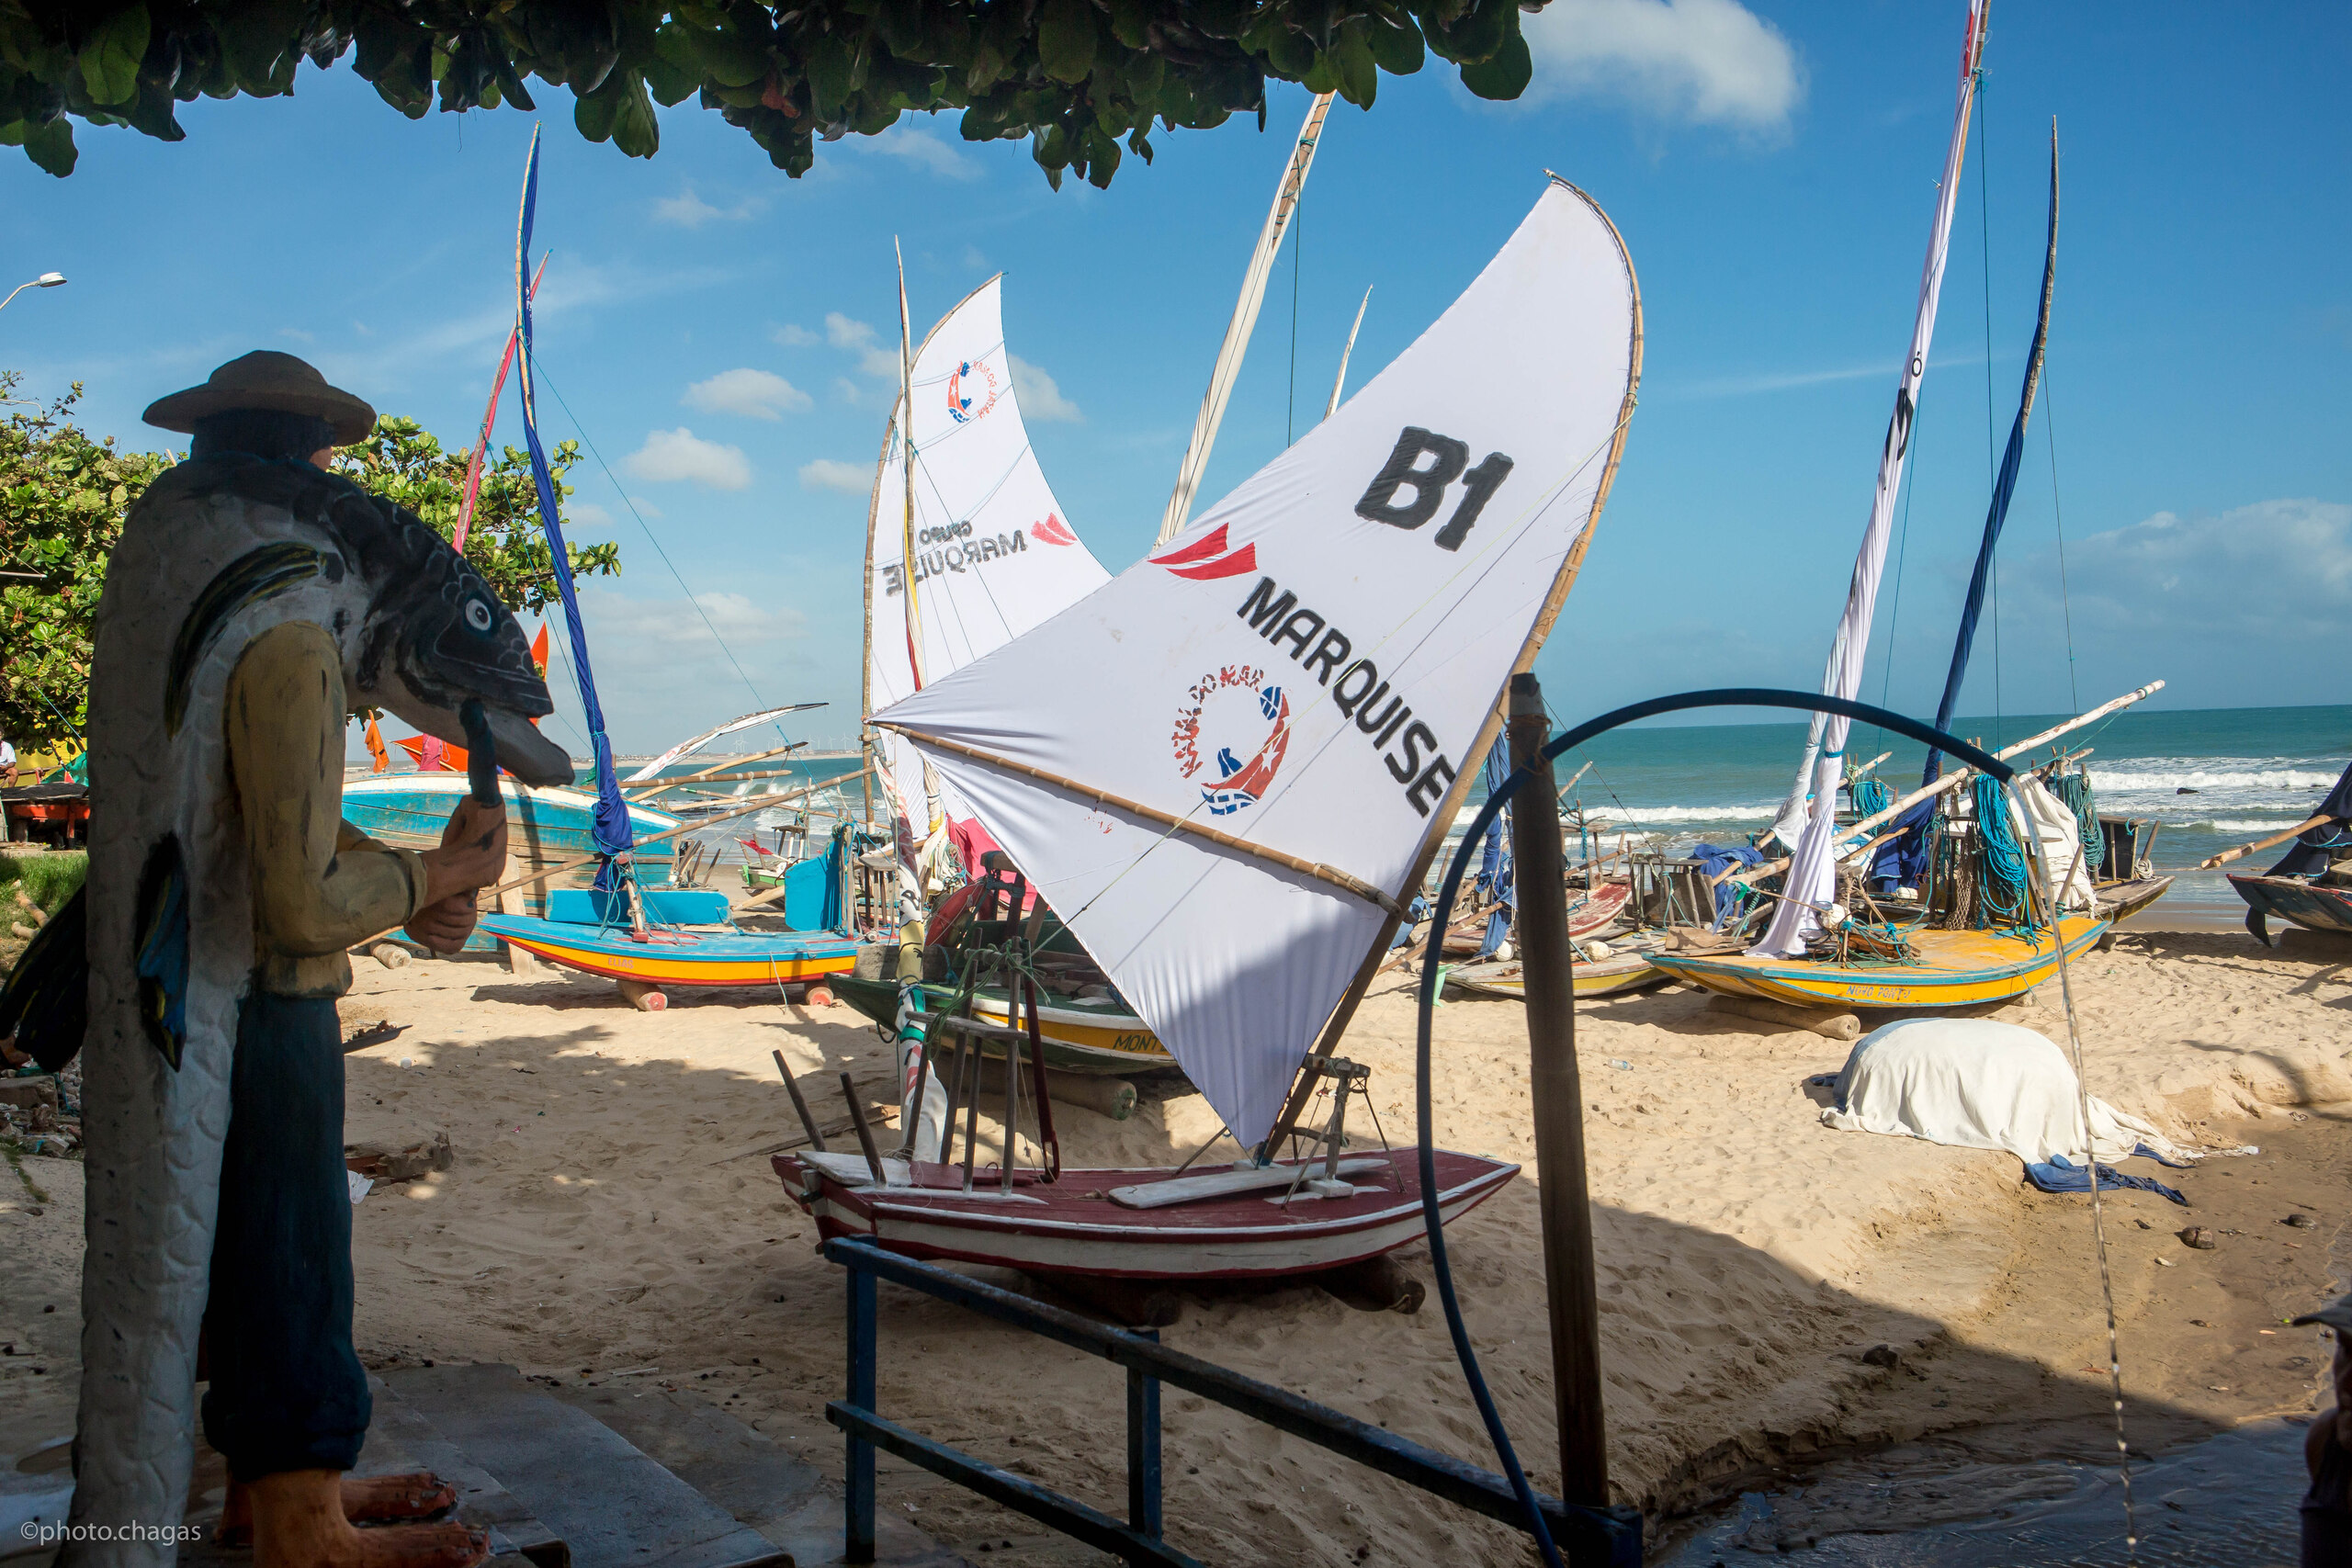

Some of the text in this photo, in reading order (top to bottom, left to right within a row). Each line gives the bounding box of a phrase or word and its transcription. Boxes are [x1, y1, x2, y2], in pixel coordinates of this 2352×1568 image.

[1354, 425, 1515, 552] B1
[1237, 576, 1457, 818] MARQUISE
[607, 956, 635, 970] ELIAS
[1112, 1034, 1168, 1052] MONT
